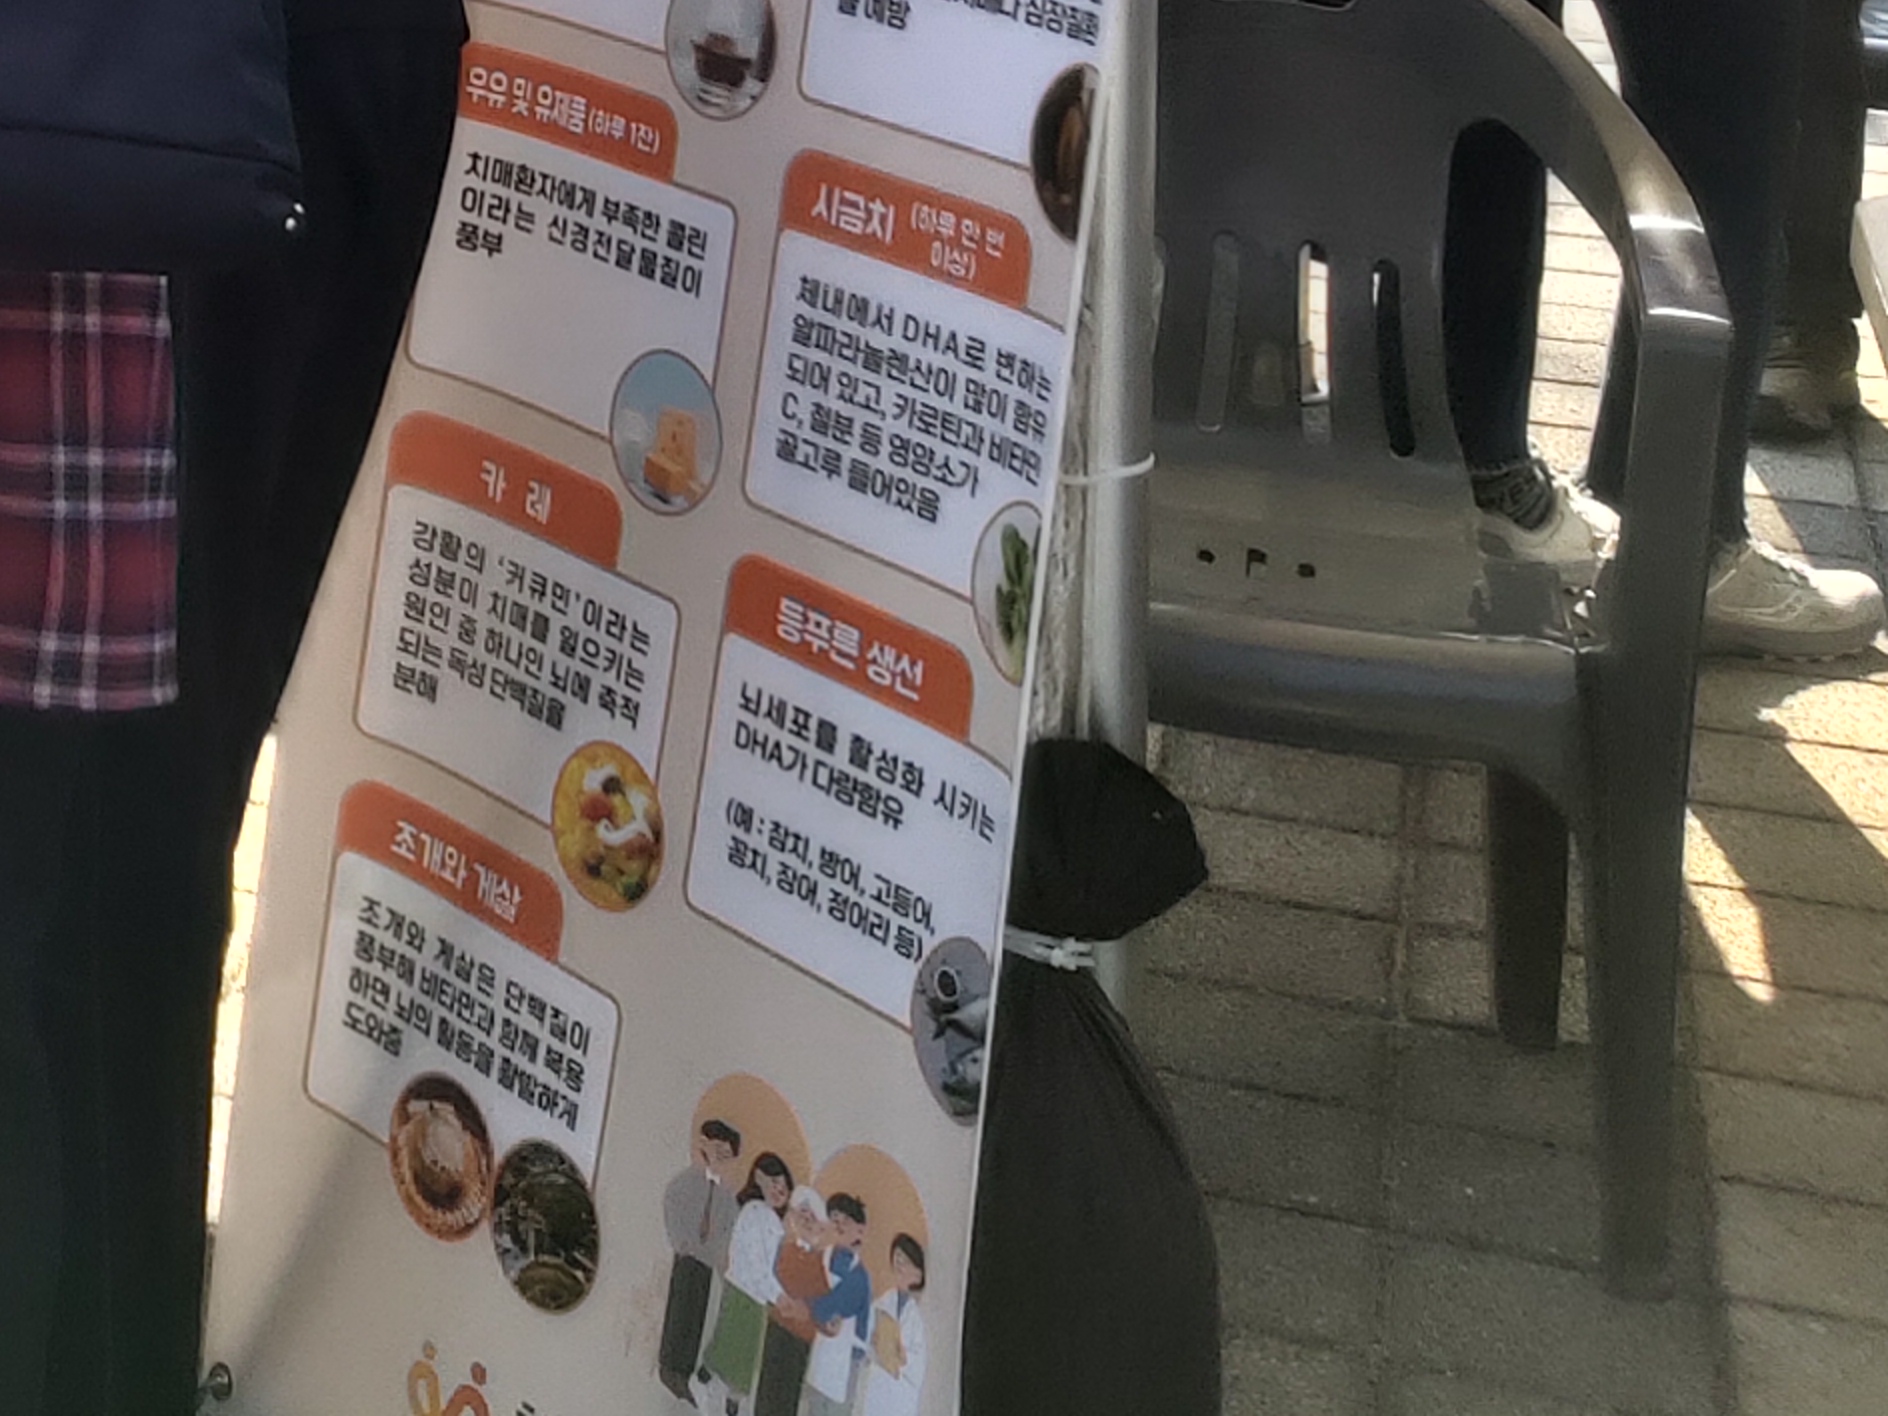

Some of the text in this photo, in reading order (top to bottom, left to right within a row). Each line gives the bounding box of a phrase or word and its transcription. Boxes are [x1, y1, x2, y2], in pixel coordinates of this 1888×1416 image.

[466, 66, 589, 136] 우유 및 유제품
[455, 220, 504, 258] 풍부
[464, 150, 708, 262] 치매환자에게 부족한 콜린
[811, 182, 895, 246] 시금치
[460, 186, 703, 300] 이라는 신경전달물질이
[797, 274, 985, 370] 체내에서 DHA로
[785, 354, 985, 453] 되어 카로틴과
[963, 376, 1008, 422] 많이
[775, 429, 940, 525] 골고루 들어있음
[810, 400, 978, 499] 철분 영양소가
[408, 557, 479, 610] 성분이
[411, 520, 486, 575] 강황의
[392, 661, 439, 705] 분해
[396, 627, 486, 690] 되는 독성
[402, 590, 641, 731] 원인 하나인 뇌에 축적
[775, 597, 924, 702] 등푸른 생선
[733, 721, 809, 783] DHA가
[738, 680, 996, 844] 뇌세포를 활성화 시키는
[390, 818, 467, 890] 조개와
[358, 895, 427, 954] 조개와
[349, 966, 433, 1038] 하면 뇌의
[419, 964, 497, 1038] 비타민과
